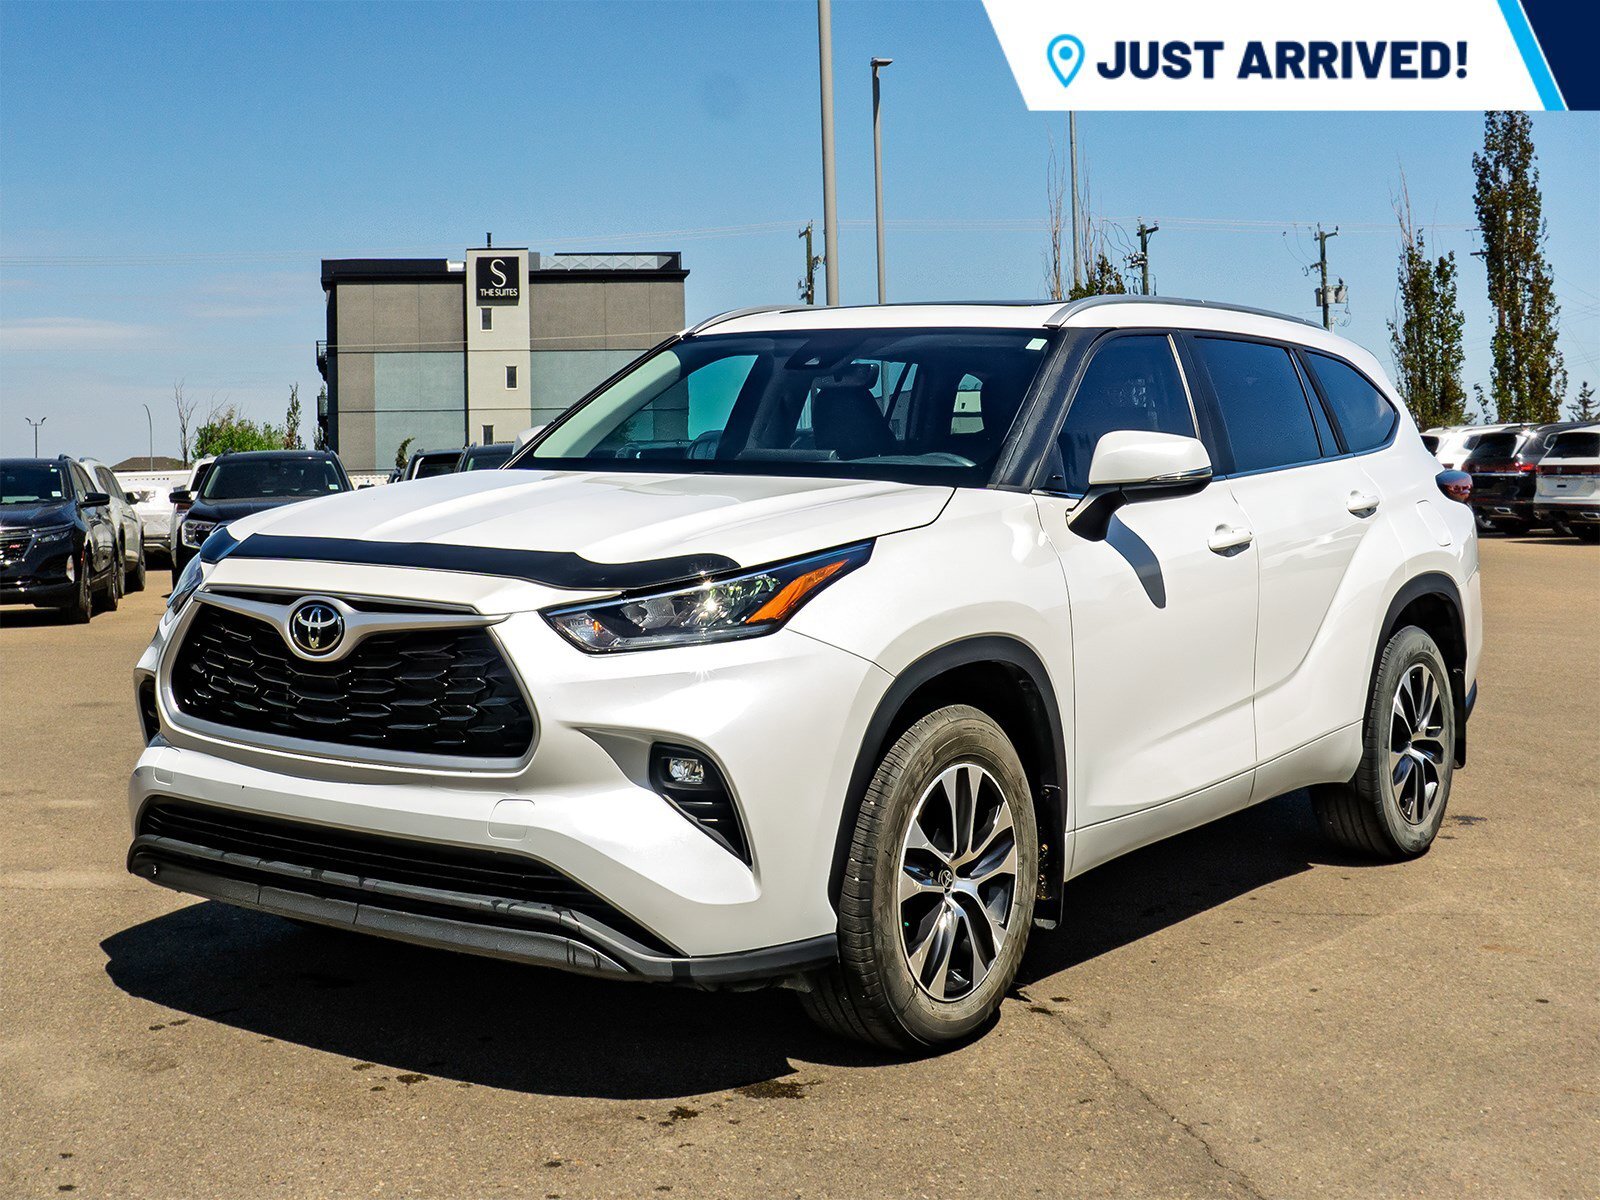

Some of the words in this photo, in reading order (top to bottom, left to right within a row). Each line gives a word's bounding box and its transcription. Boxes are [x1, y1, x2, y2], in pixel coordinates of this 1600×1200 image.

[490, 259, 507, 287] S
[480, 288, 494, 296] THE
[495, 288, 518, 296] SUITES
